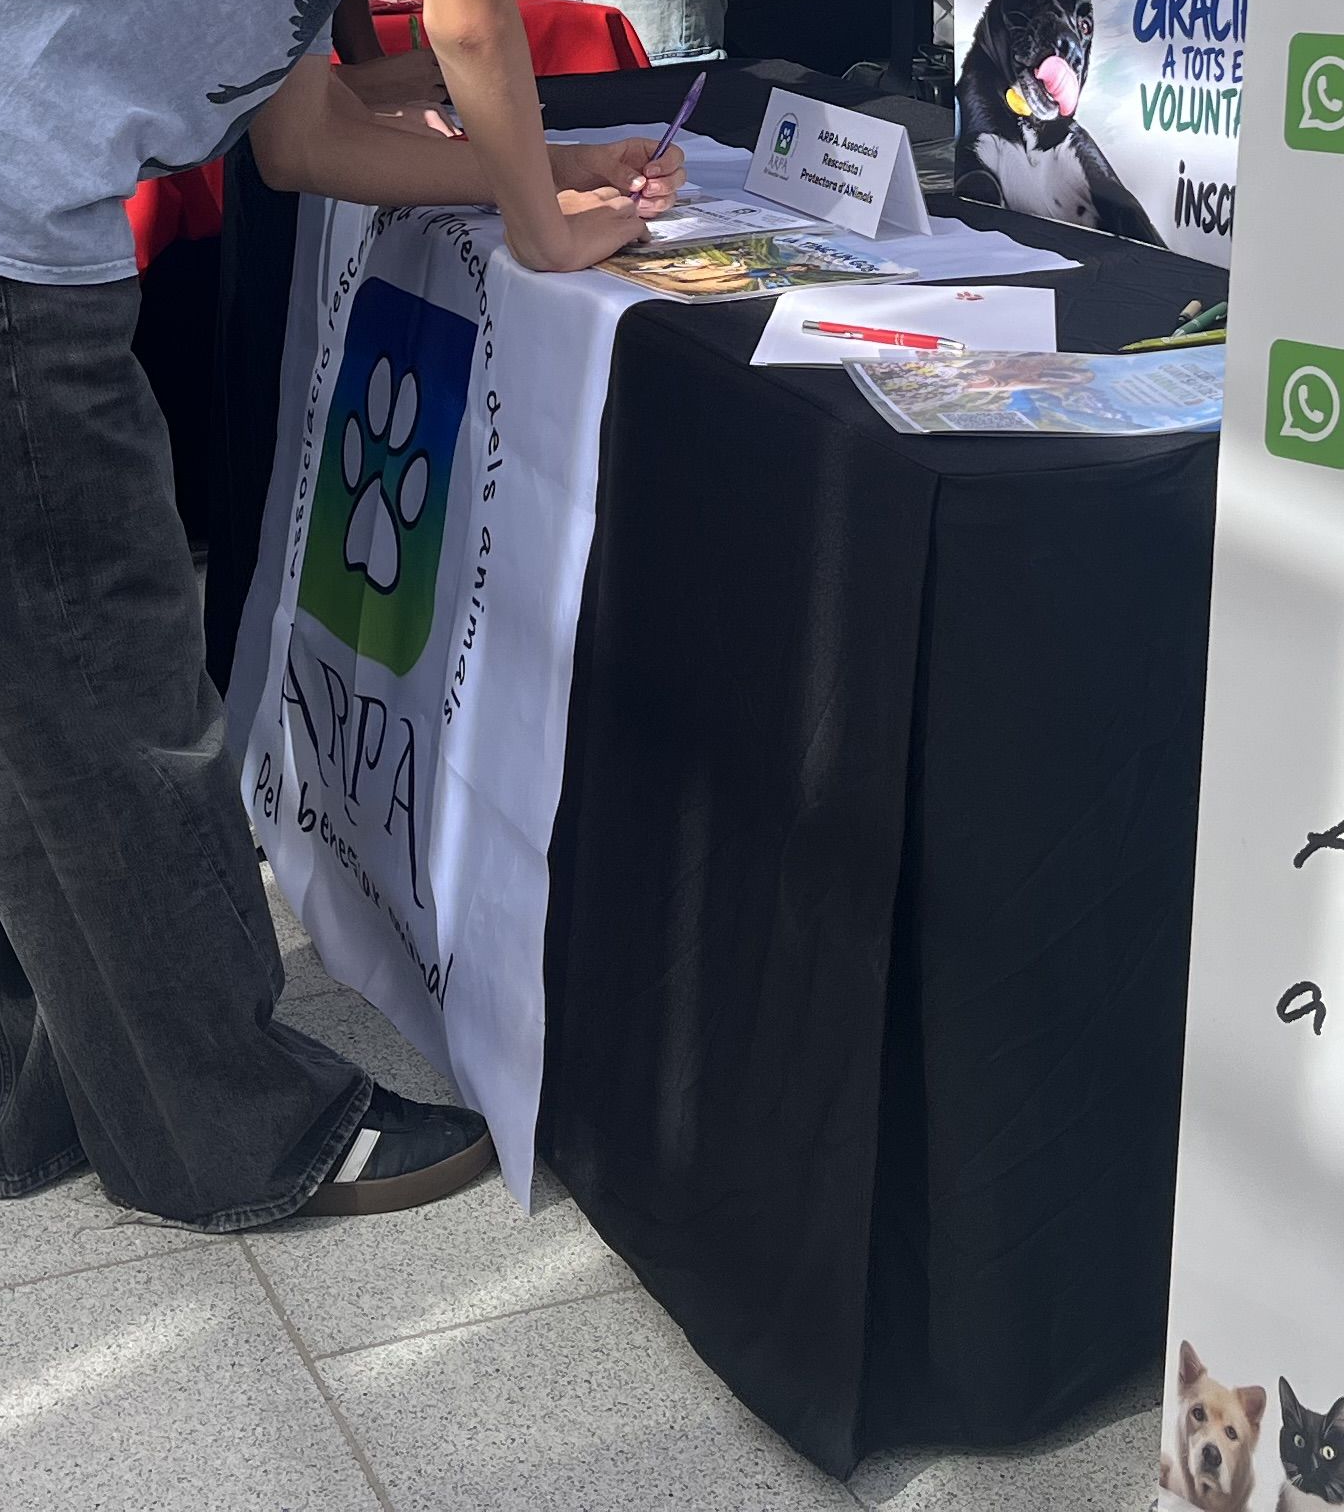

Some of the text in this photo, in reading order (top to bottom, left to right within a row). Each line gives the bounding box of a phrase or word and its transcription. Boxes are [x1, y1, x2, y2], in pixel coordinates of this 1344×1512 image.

[1162, 43, 1176, 79] A
[1182, 45, 1225, 83] TOTS
[800, 168, 838, 191] Protectora
[423, 213, 494, 371] protectora
[483, 390, 503, 502] dels
[444, 526, 491, 725] animals
[253, 752, 283, 825] Pel
[279, 622, 424, 909] ARPA
[1275, 980, 1326, 1036] a
